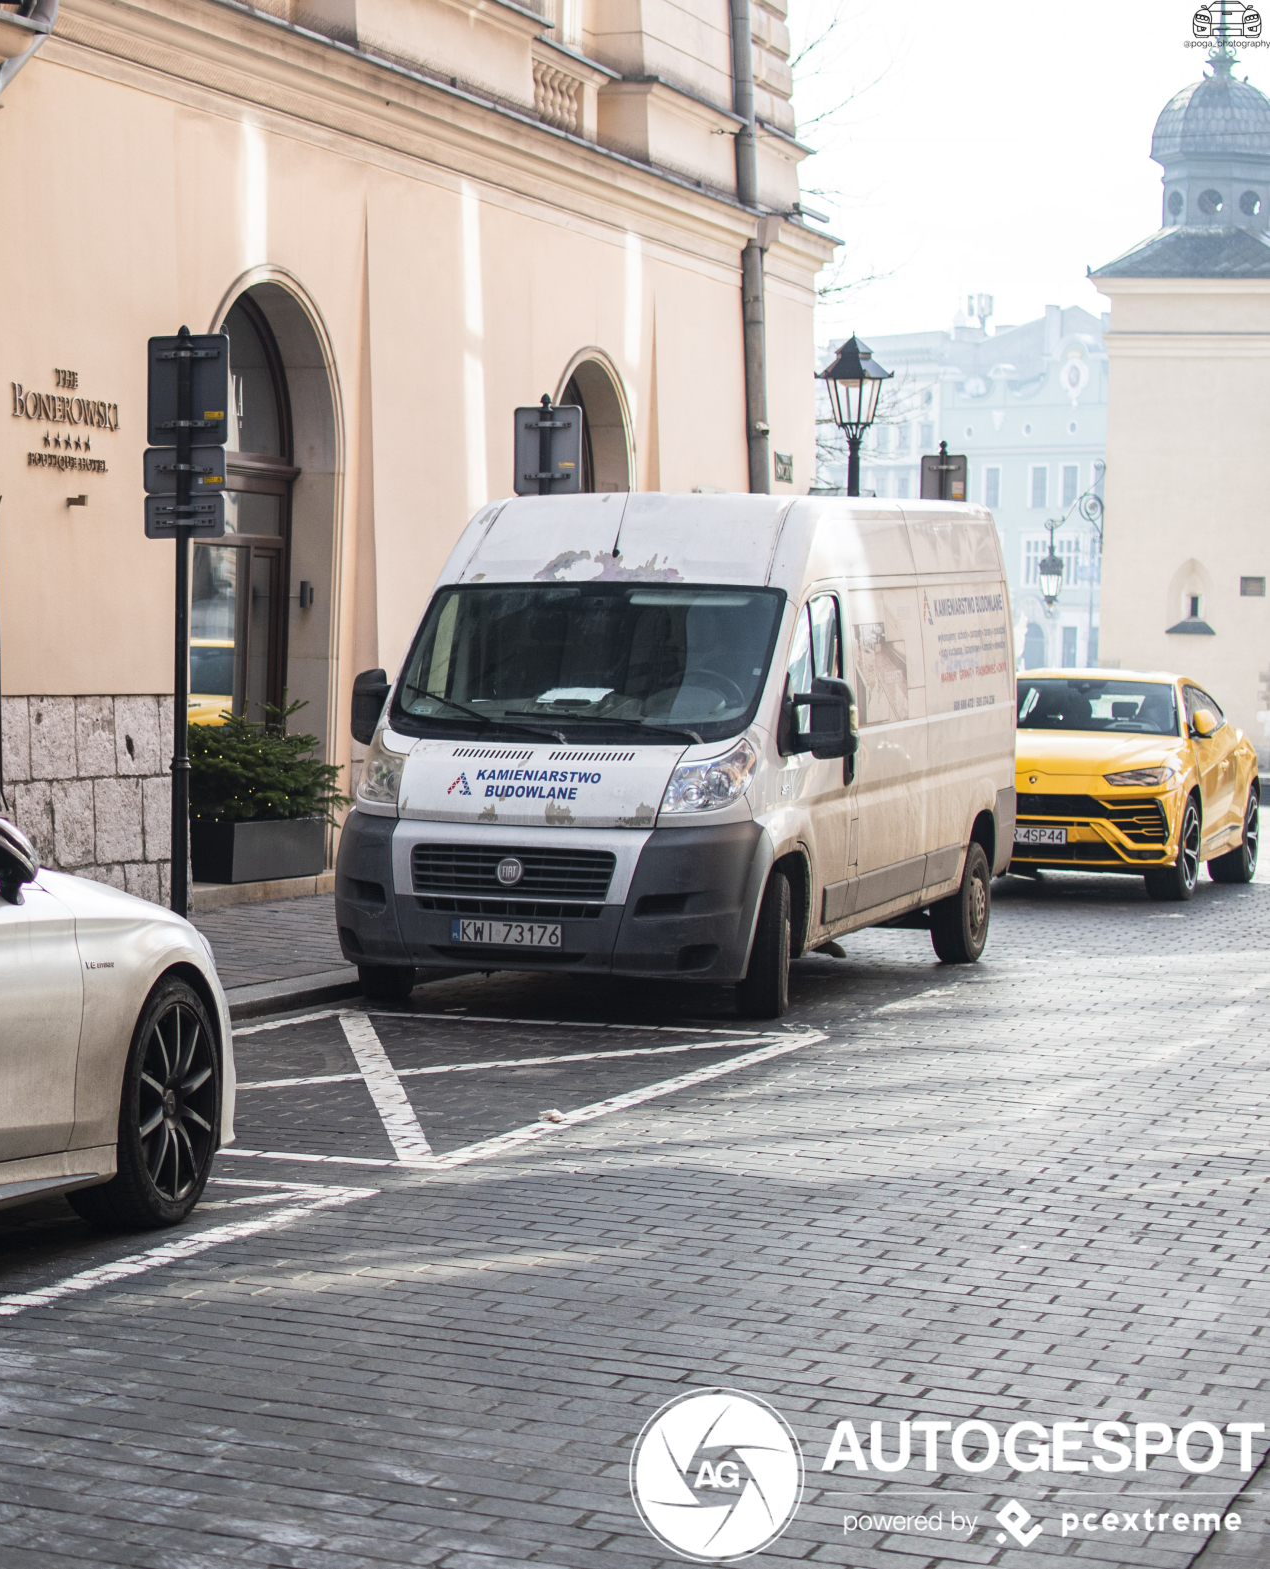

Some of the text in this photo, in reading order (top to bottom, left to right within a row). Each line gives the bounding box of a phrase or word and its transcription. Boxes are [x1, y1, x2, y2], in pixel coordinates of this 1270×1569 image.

[54, 368, 78, 389] THE
[12, 381, 121, 432] BONEROWSKI
[28, 452, 77, 472] BOUTIQUE
[476, 769, 602, 785] KAMIENIARSTWO
[485, 785, 578, 801] BUDOWLANE
[1023, 829, 1063, 843] 4SP44
[502, 865, 517, 878] FIAT
[462, 921, 492, 942] KWI
[503, 923, 559, 945] 73176
